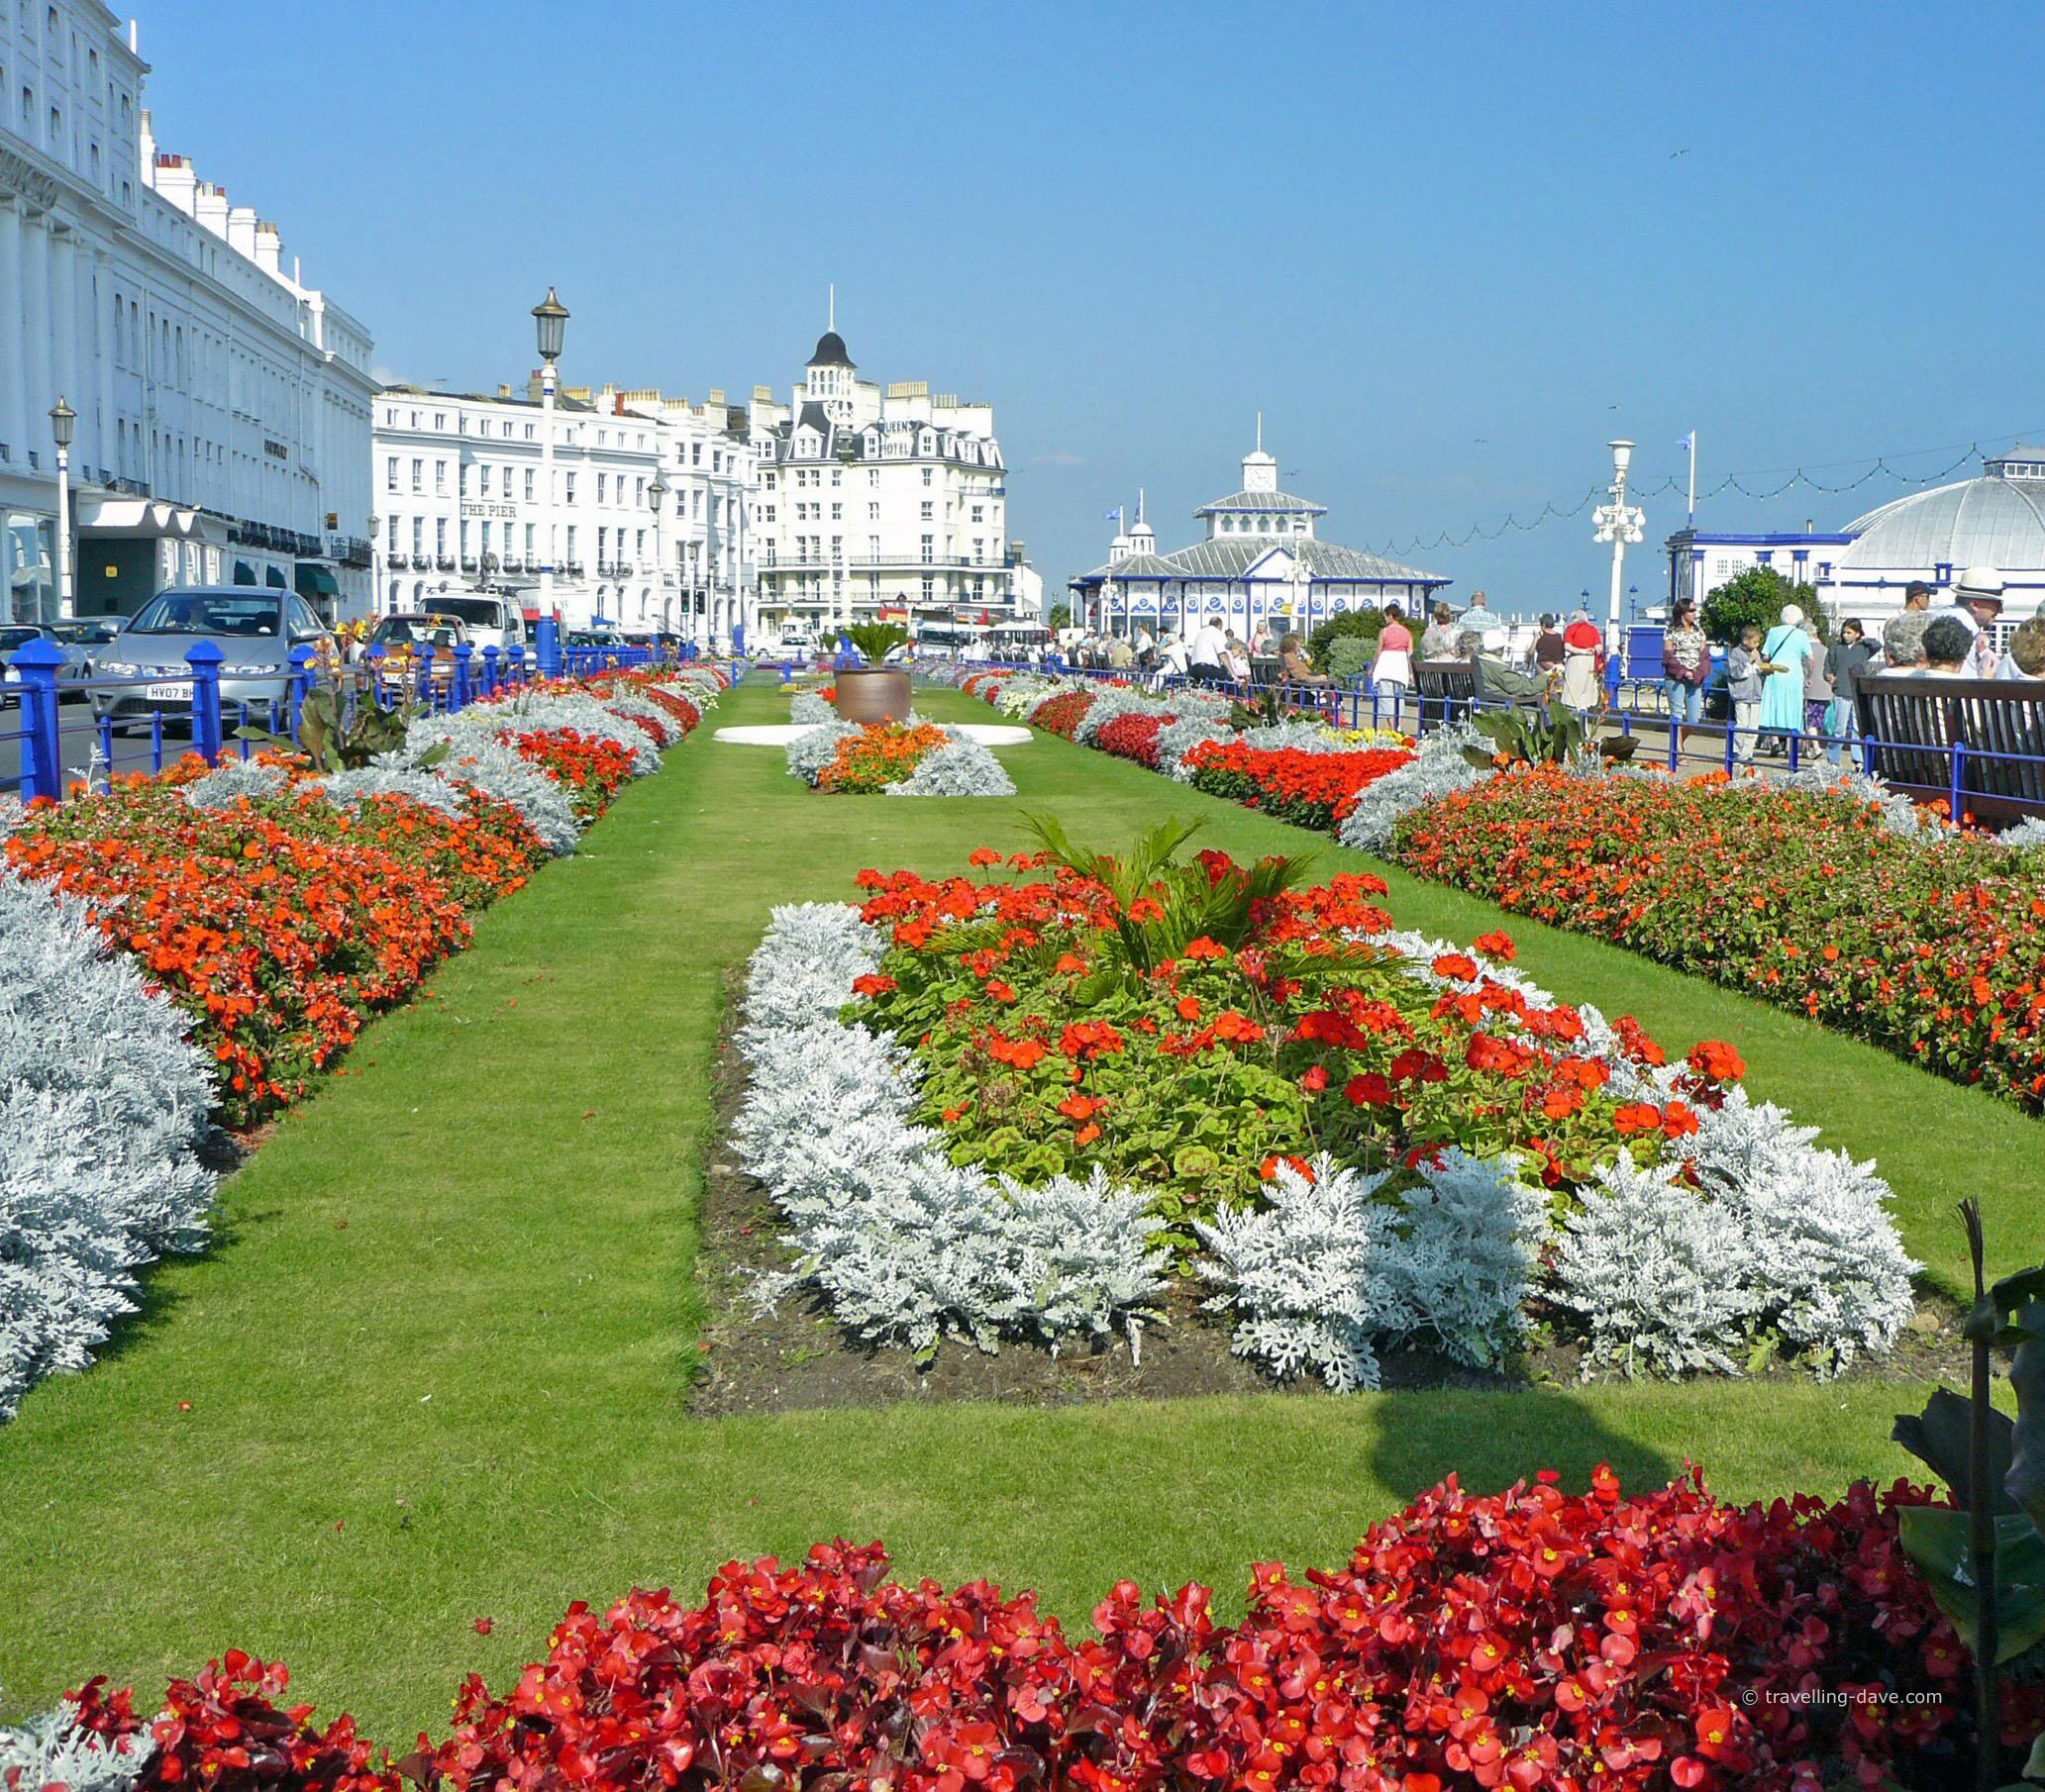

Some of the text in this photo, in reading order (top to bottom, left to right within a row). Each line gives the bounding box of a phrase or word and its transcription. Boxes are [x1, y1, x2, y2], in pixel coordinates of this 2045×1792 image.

[878, 436, 910, 457] HOTEL
[460, 504, 517, 518] THE PIER
[152, 688, 179, 698] HV07
